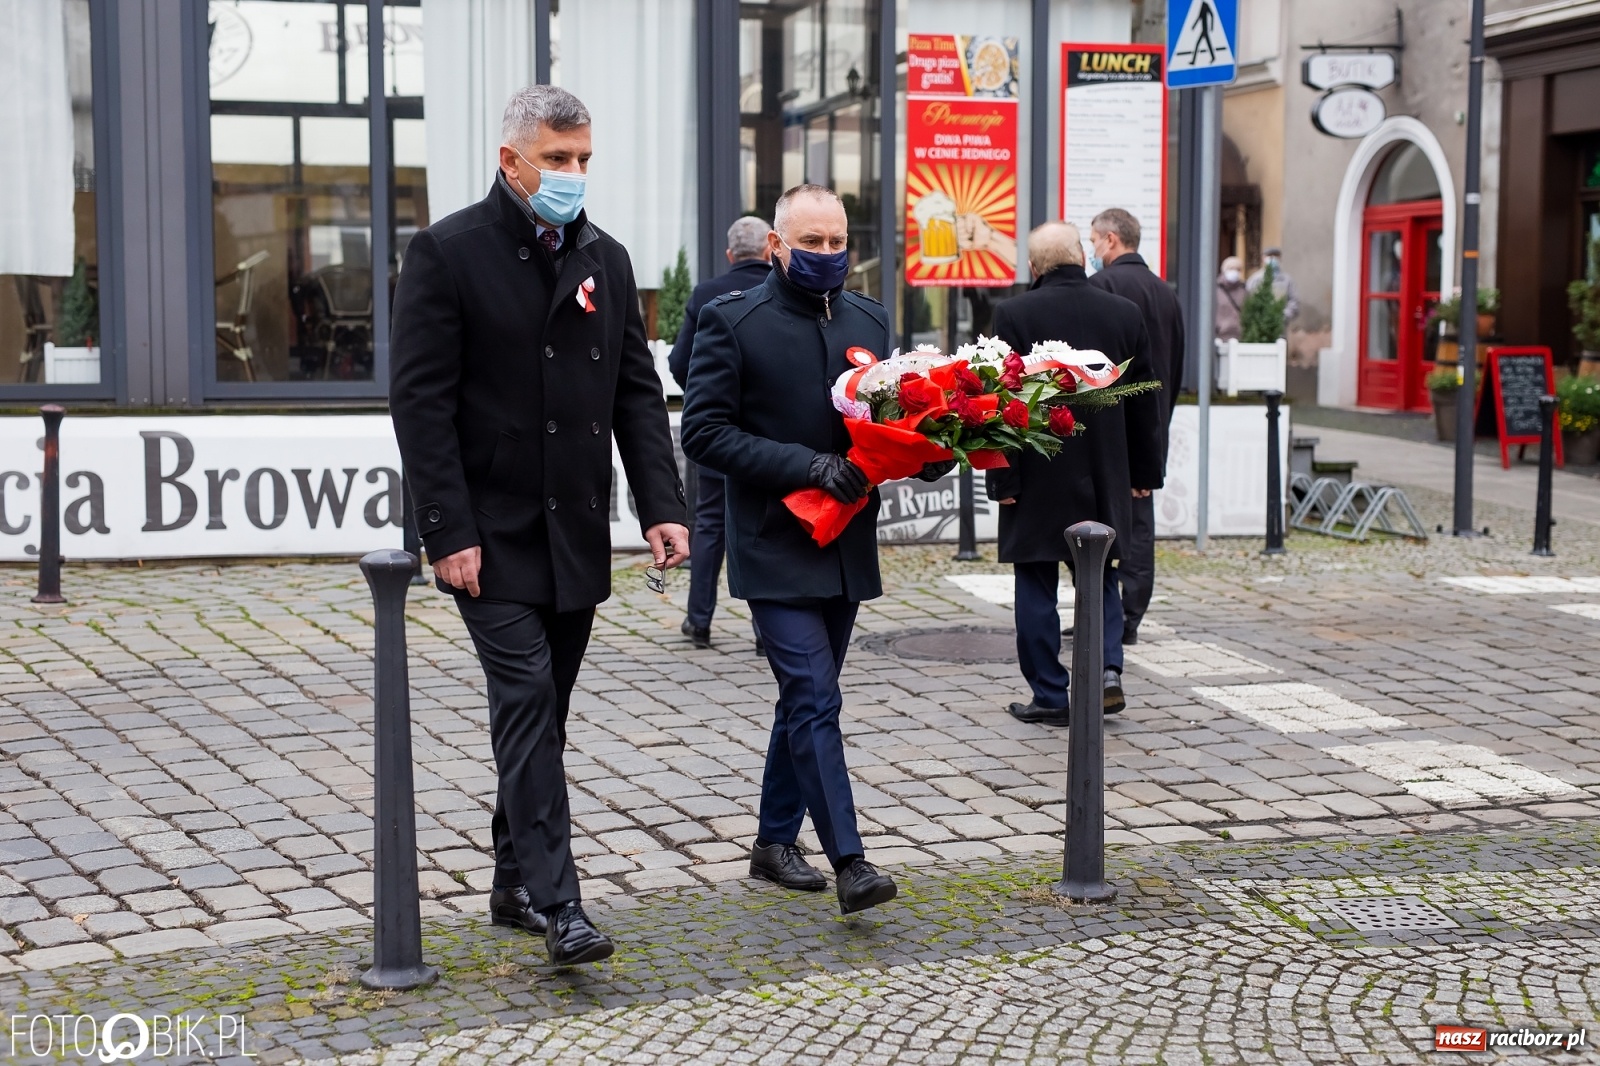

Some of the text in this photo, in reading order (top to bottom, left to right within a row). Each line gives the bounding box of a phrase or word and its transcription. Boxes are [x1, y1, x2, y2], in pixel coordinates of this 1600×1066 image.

[1080, 52, 1151, 73] LUNCH
[922, 101, 1006, 133] Promocja
[934, 133, 992, 147] DWA PIWA
[914, 147, 1011, 161] W CENIE JEDNEGO
